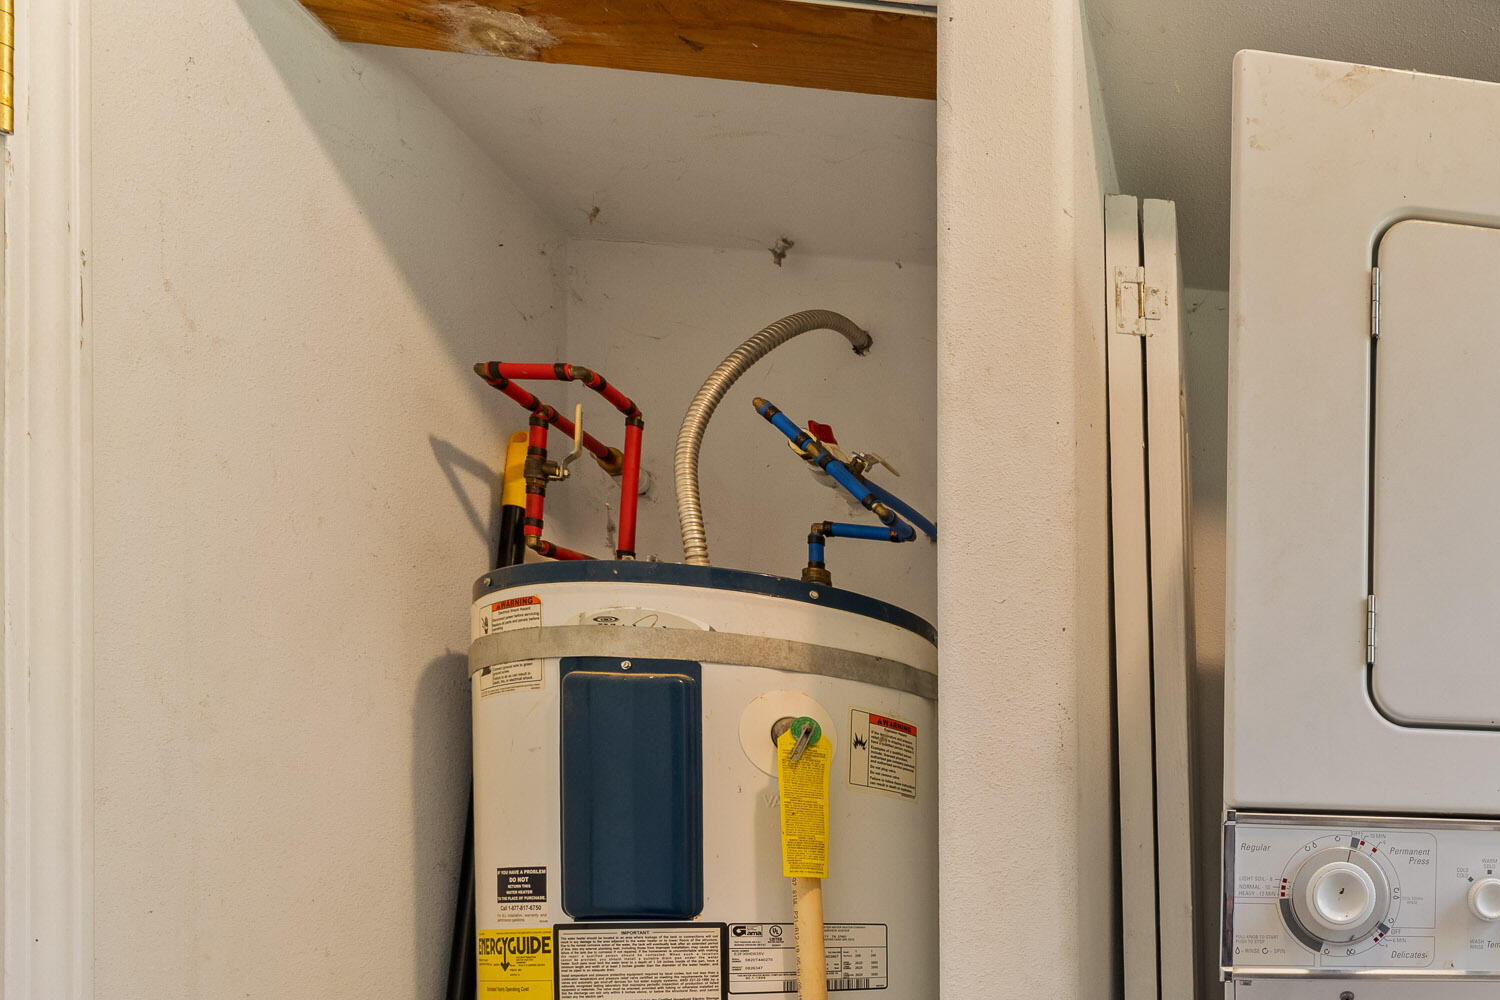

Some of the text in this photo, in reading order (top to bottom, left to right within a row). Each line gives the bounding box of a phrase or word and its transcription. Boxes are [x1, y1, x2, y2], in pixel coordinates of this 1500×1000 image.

[501, 597, 533, 608] WARNING
[883, 720, 912, 734] WARNING
[1240, 843, 1272, 852] Regular
[1389, 847, 1431, 856] Permanent
[1409, 857, 1430, 865] Press
[479, 936, 552, 955] ENERGYGUIDE
[1391, 950, 1426, 959] Delicates
